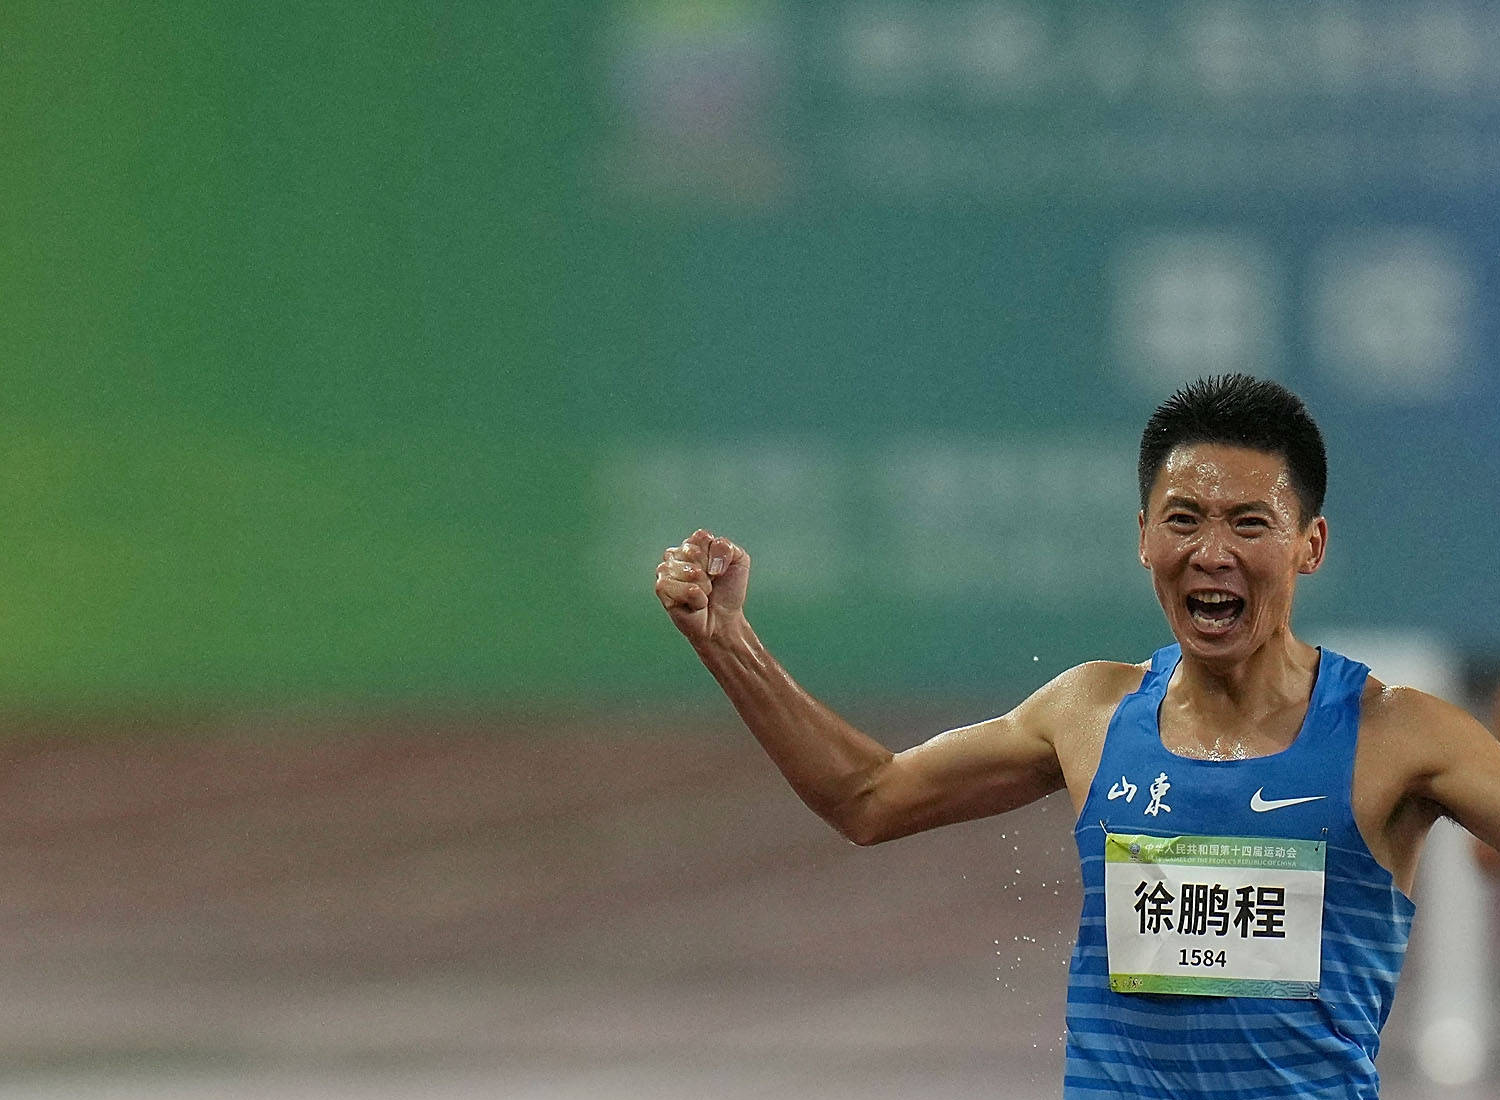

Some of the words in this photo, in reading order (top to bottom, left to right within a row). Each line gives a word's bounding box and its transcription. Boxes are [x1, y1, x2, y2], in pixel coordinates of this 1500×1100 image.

[1133, 881, 1287, 939] 徐鹏程
[1178, 948, 1227, 968] 1584
